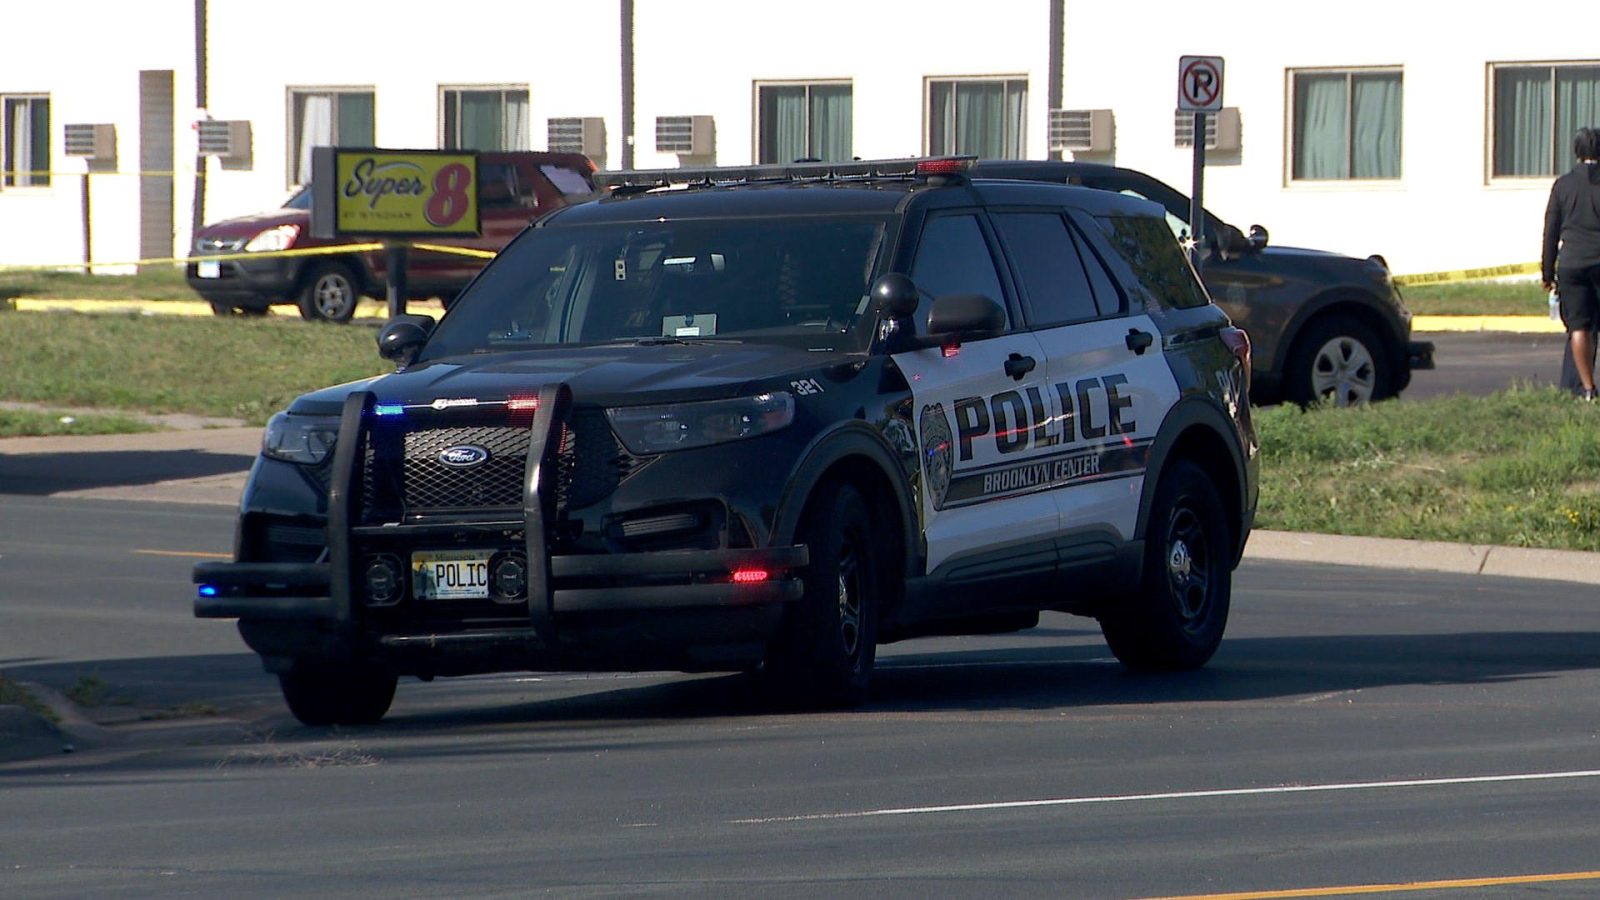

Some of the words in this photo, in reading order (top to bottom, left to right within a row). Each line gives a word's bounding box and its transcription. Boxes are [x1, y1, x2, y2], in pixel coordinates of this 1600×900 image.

[344, 158, 426, 210] Super
[424, 163, 471, 227] 8
[790, 378, 825, 396] 321
[953, 373, 1136, 462] POLICE
[447, 450, 476, 463] Ford
[983, 465, 1051, 494] BROOKLYN
[1053, 454, 1100, 481] CENTER
[435, 562, 487, 588] POLIC
